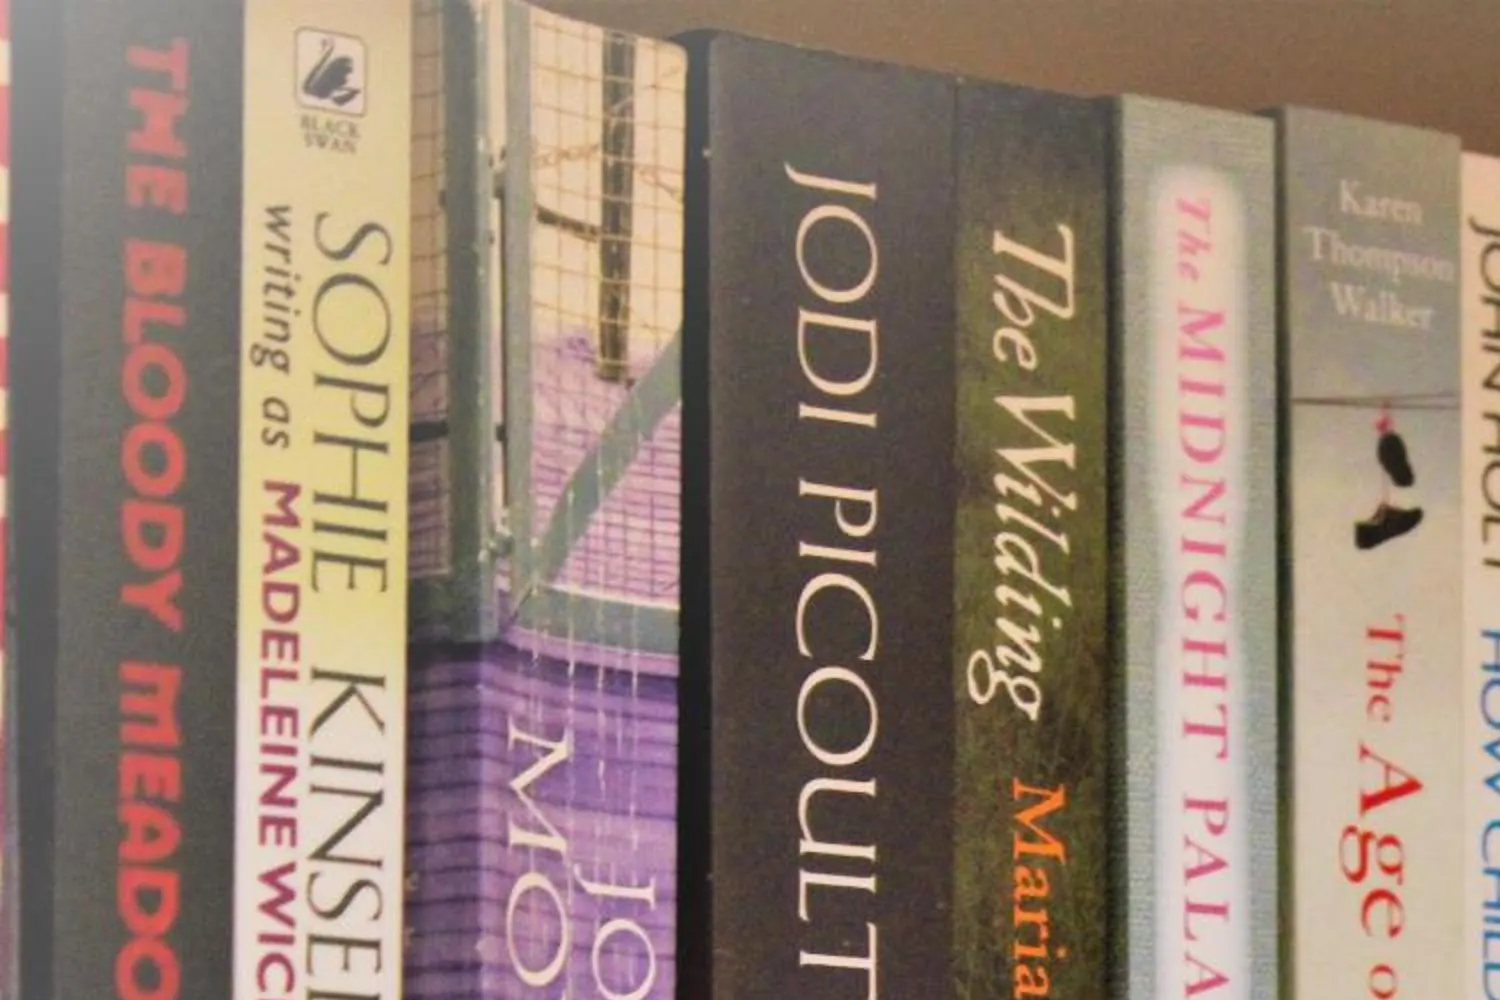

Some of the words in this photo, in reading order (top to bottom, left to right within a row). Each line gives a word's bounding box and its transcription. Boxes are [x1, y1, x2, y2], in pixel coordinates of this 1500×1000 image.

[125, 37, 190, 214] THE
[301, 114, 361, 139] BLACK
[303, 134, 358, 155] SWAN
[1339, 179, 1424, 225] Karen
[250, 204, 301, 375] writing
[783, 160, 878, 429] JODI
[991, 223, 1076, 372] The
[1175, 197, 1212, 282] The
[1303, 225, 1456, 284] Thompson
[1329, 280, 1434, 331] Walker
[119, 239, 189, 633] BLOODY
[260, 397, 293, 449] as
[310, 211, 393, 594] SOPHIE
[966, 394, 1077, 721] Wilding
[1177, 305, 1230, 760] MIDNIGHT
[256, 480, 302, 848] MADELEINE
[1365, 613, 1407, 724] The
[1012, 776, 1069, 999] Maria
[1338, 743, 1425, 939] Age
